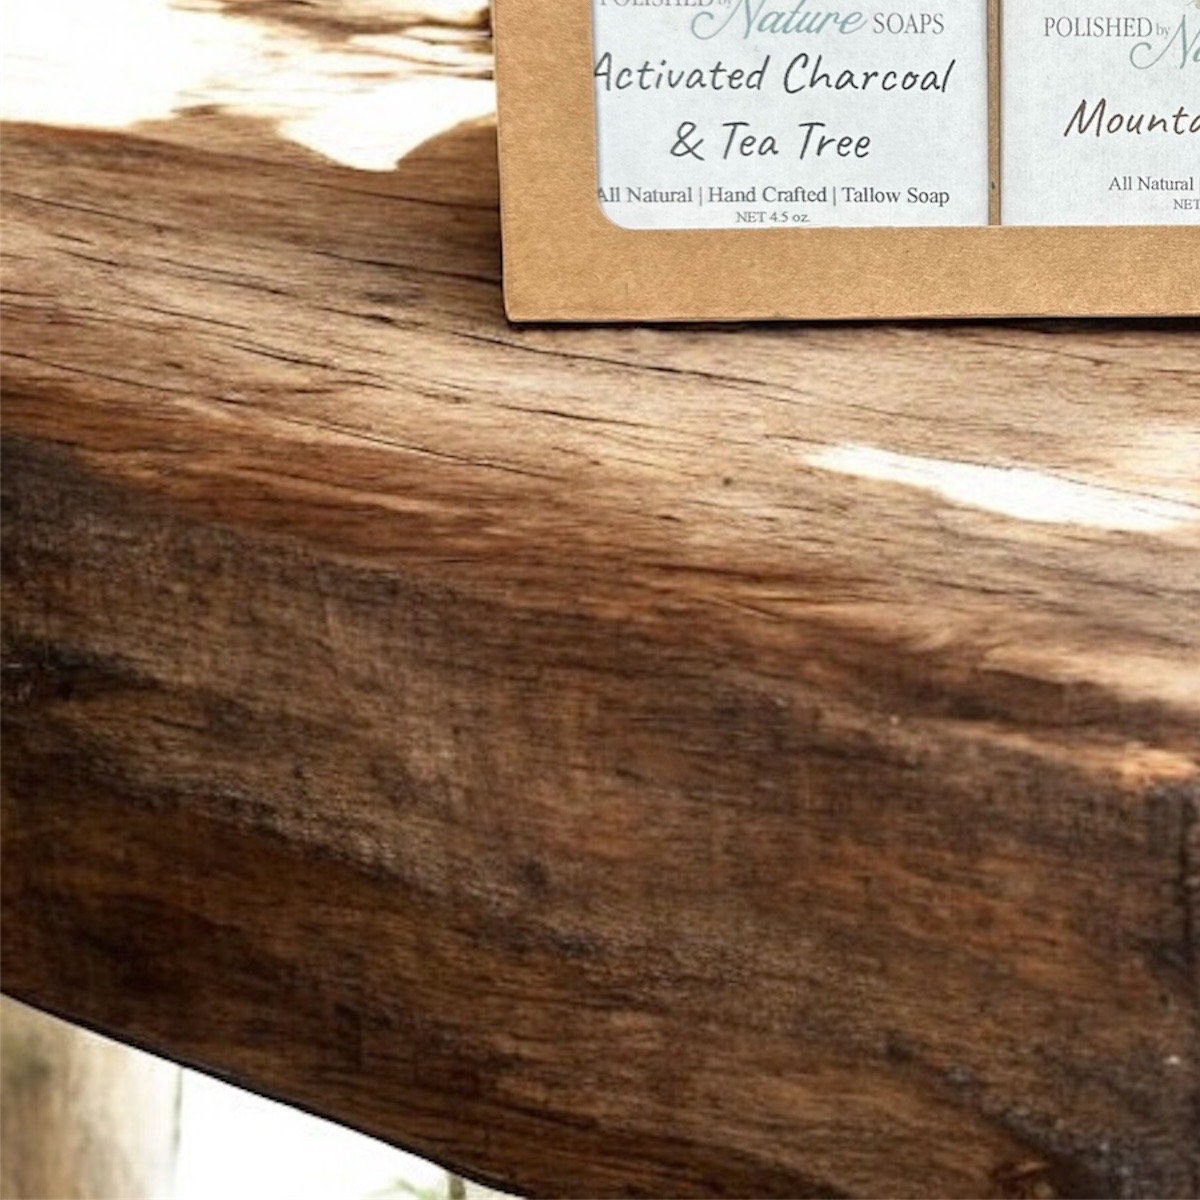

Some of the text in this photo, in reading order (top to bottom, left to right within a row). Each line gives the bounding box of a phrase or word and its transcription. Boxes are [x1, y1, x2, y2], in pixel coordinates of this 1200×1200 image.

[872, 12, 945, 35] SOAPS
[1043, 15, 1154, 39] POLISHED
[1155, 21, 1172, 41] by
[593, 51, 957, 94] Activated Charcoal
[669, 120, 871, 161] & Tea Tree
[1107, 175, 1133, 192] All
[1137, 175, 1195, 192] Natural
[597, 186, 621, 203] All
[626, 186, 693, 203] Natural
[707, 186, 757, 203] Hand
[761, 186, 828, 203] Crafted
[841, 186, 902, 204] Tallow
[906, 187, 951, 208] Soap
[735, 210, 767, 223] NET
[769, 210, 789, 223] 4.5
